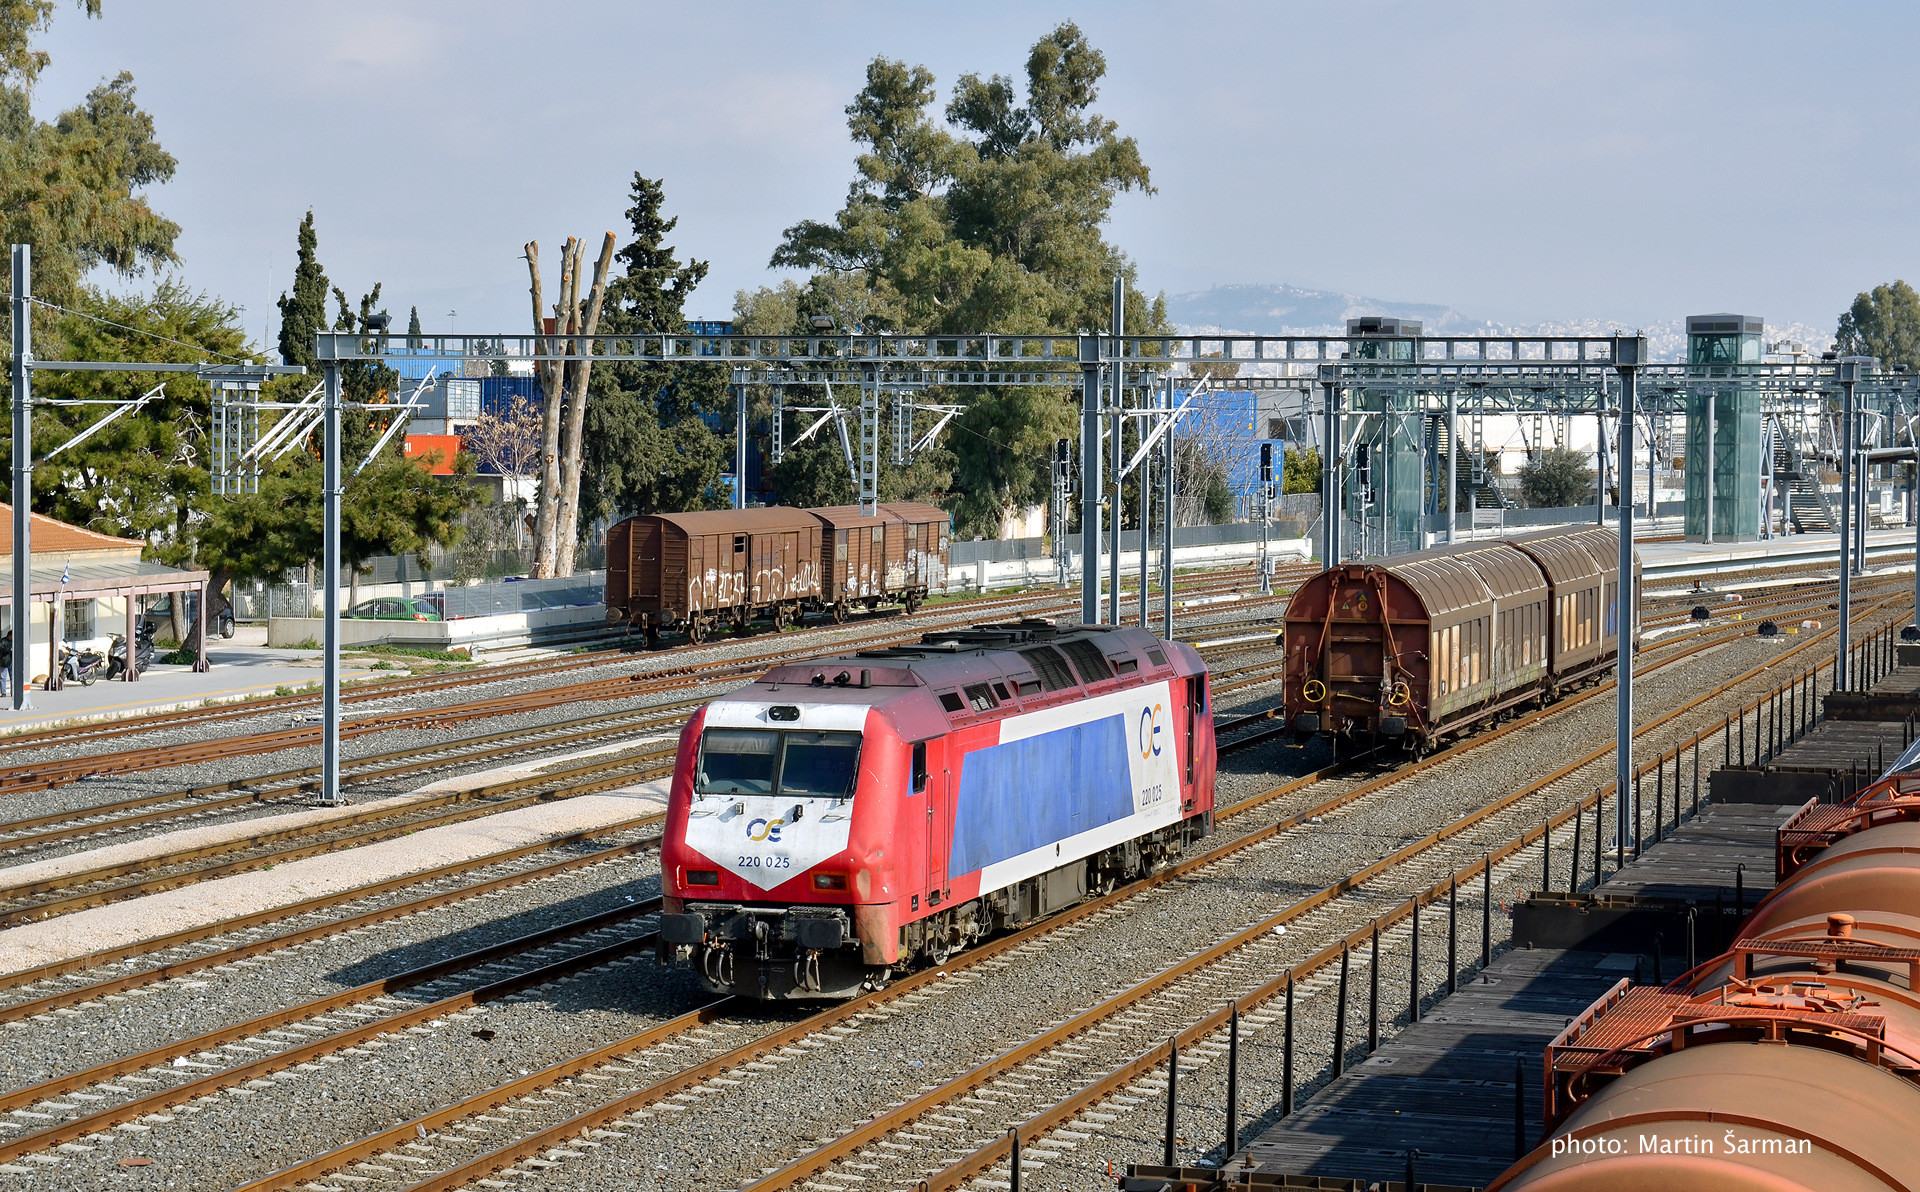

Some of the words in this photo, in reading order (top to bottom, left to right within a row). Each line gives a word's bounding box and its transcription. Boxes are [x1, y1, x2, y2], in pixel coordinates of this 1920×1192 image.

[1141, 787, 1152, 806] 220
[1152, 784, 1162, 802] 025
[738, 856, 761, 867] 220
[765, 857, 790, 868] 025
